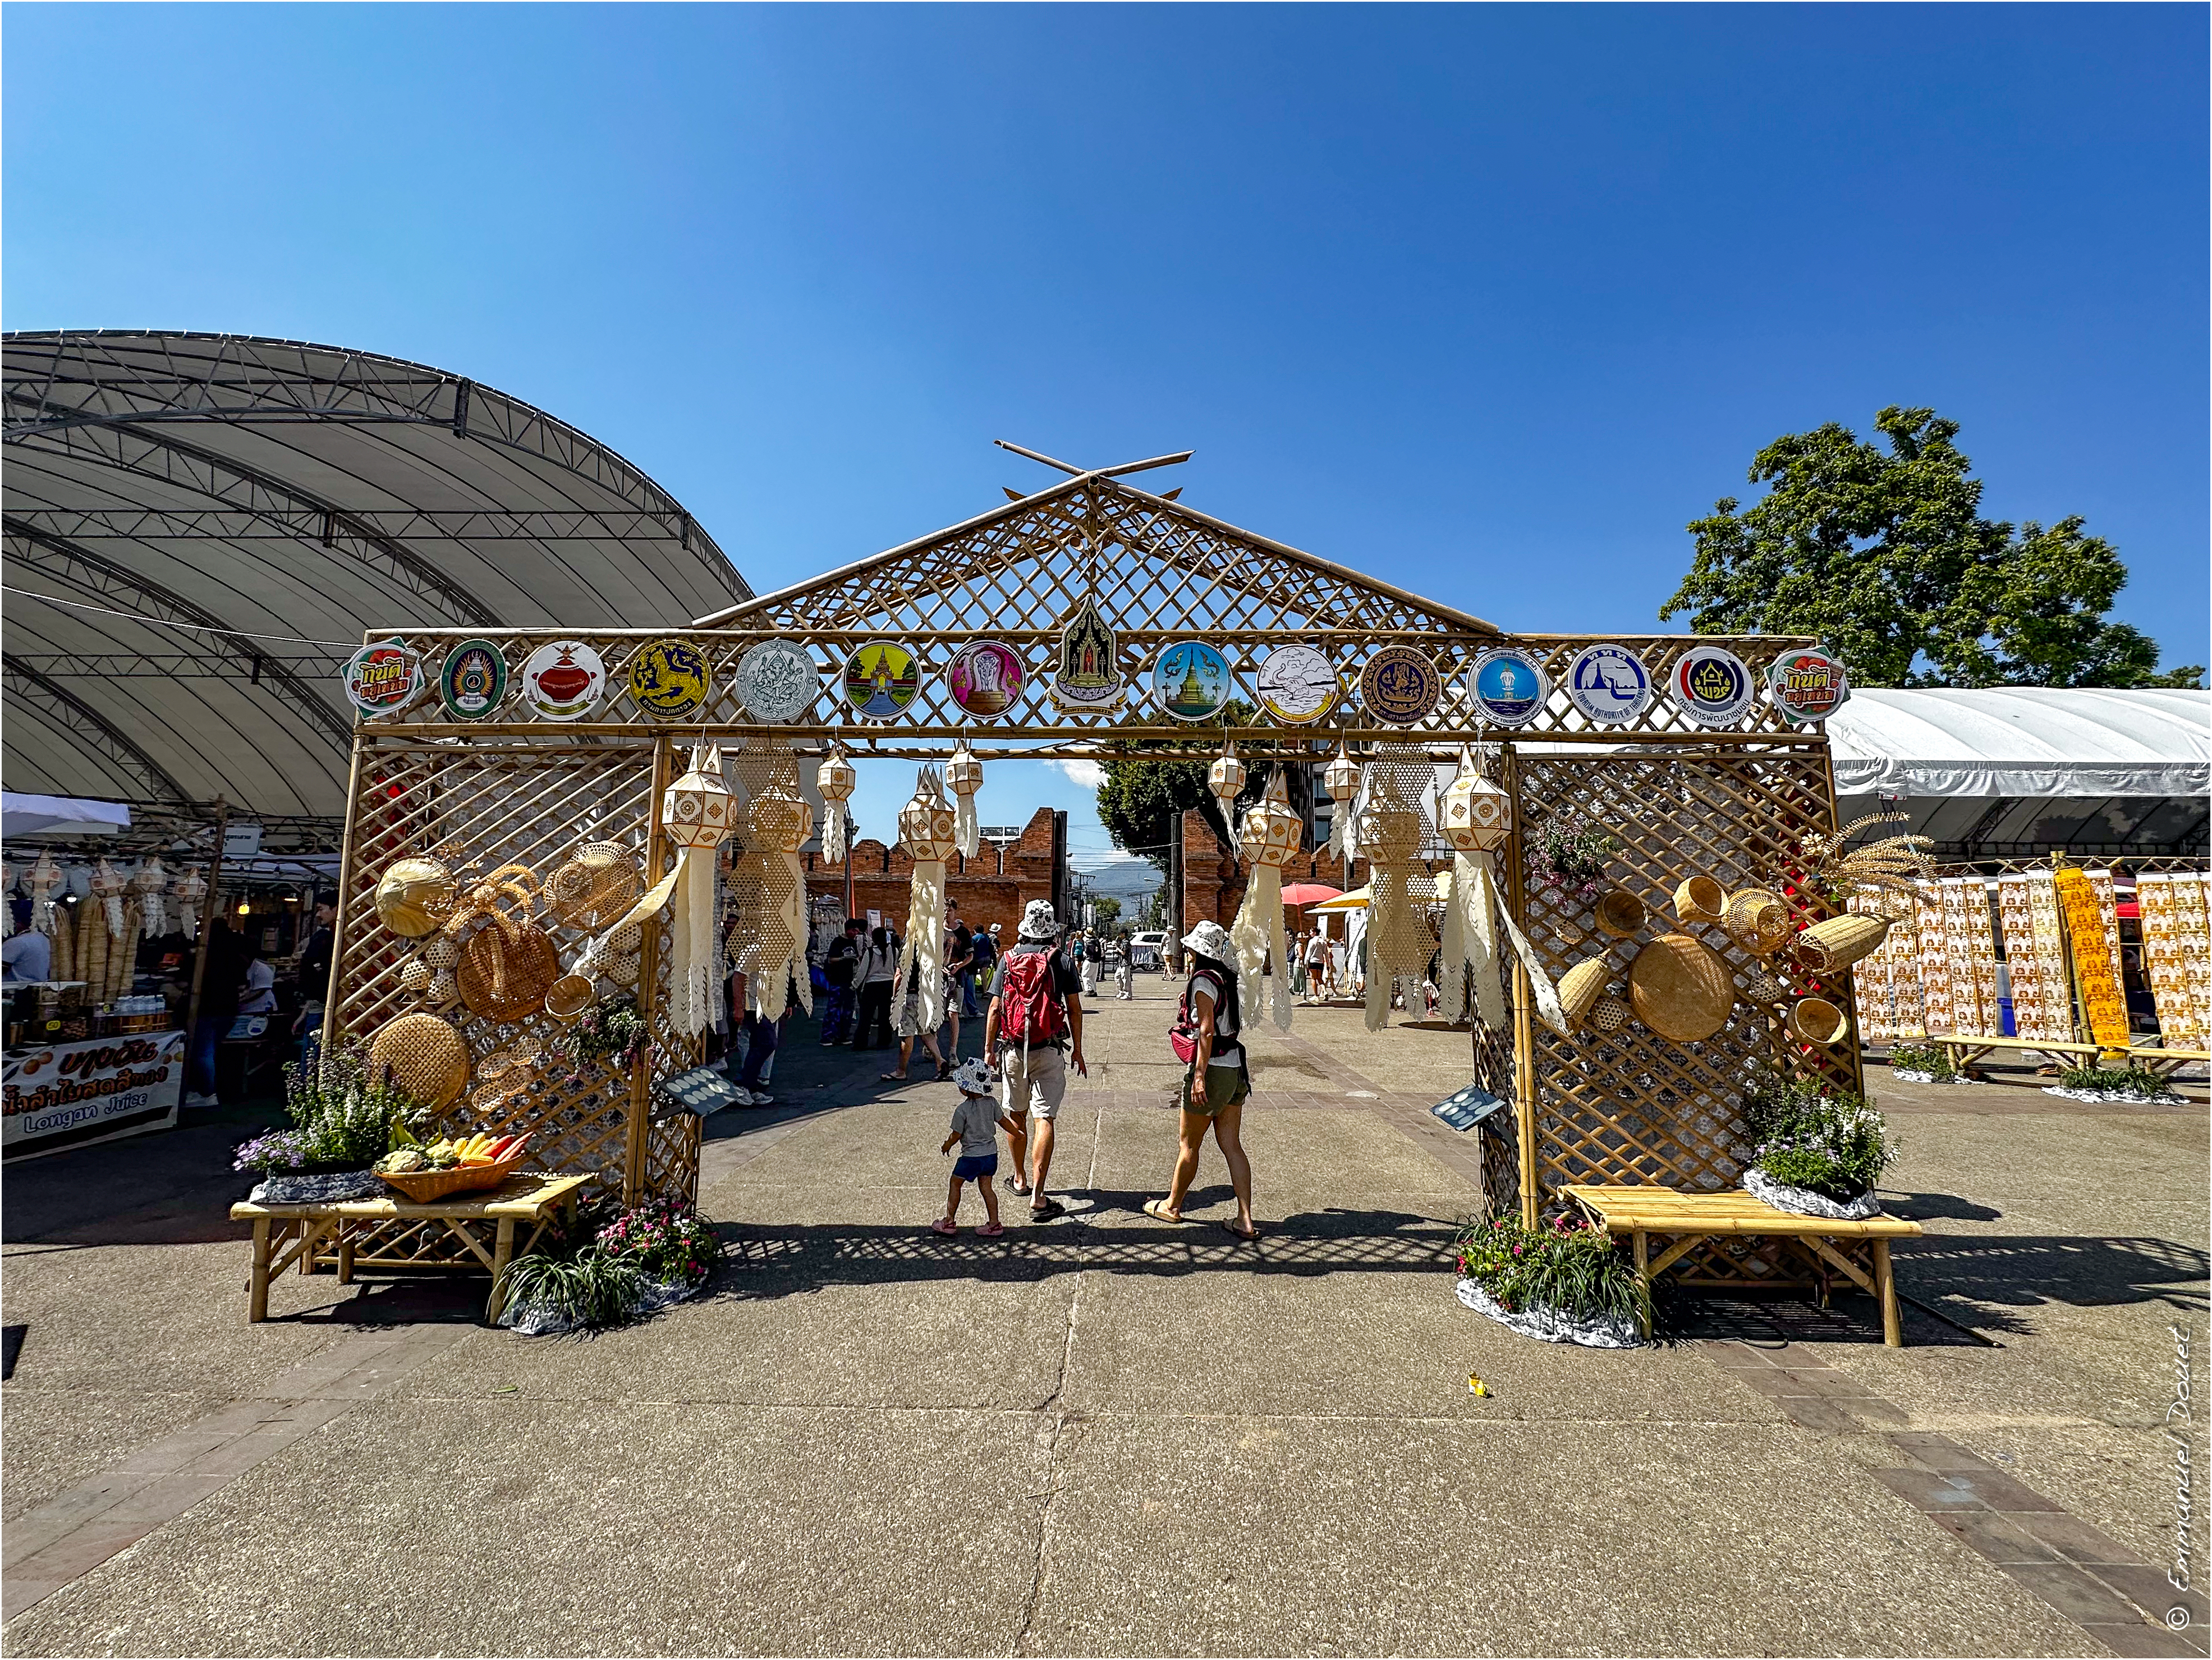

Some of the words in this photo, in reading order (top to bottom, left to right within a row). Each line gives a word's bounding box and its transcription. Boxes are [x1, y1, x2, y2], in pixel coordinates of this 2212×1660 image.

[360, 659, 402, 684] กินดี
[1784, 666, 1828, 689] กินดี
[1594, 707, 1623, 719] AUTHORITY
[1623, 707, 1630, 716] OF
[1677, 698, 1750, 722] กรมการพัฒนาชุมชน
[24, 1104, 98, 1133] Longan
[104, 1093, 148, 1114] Juice
